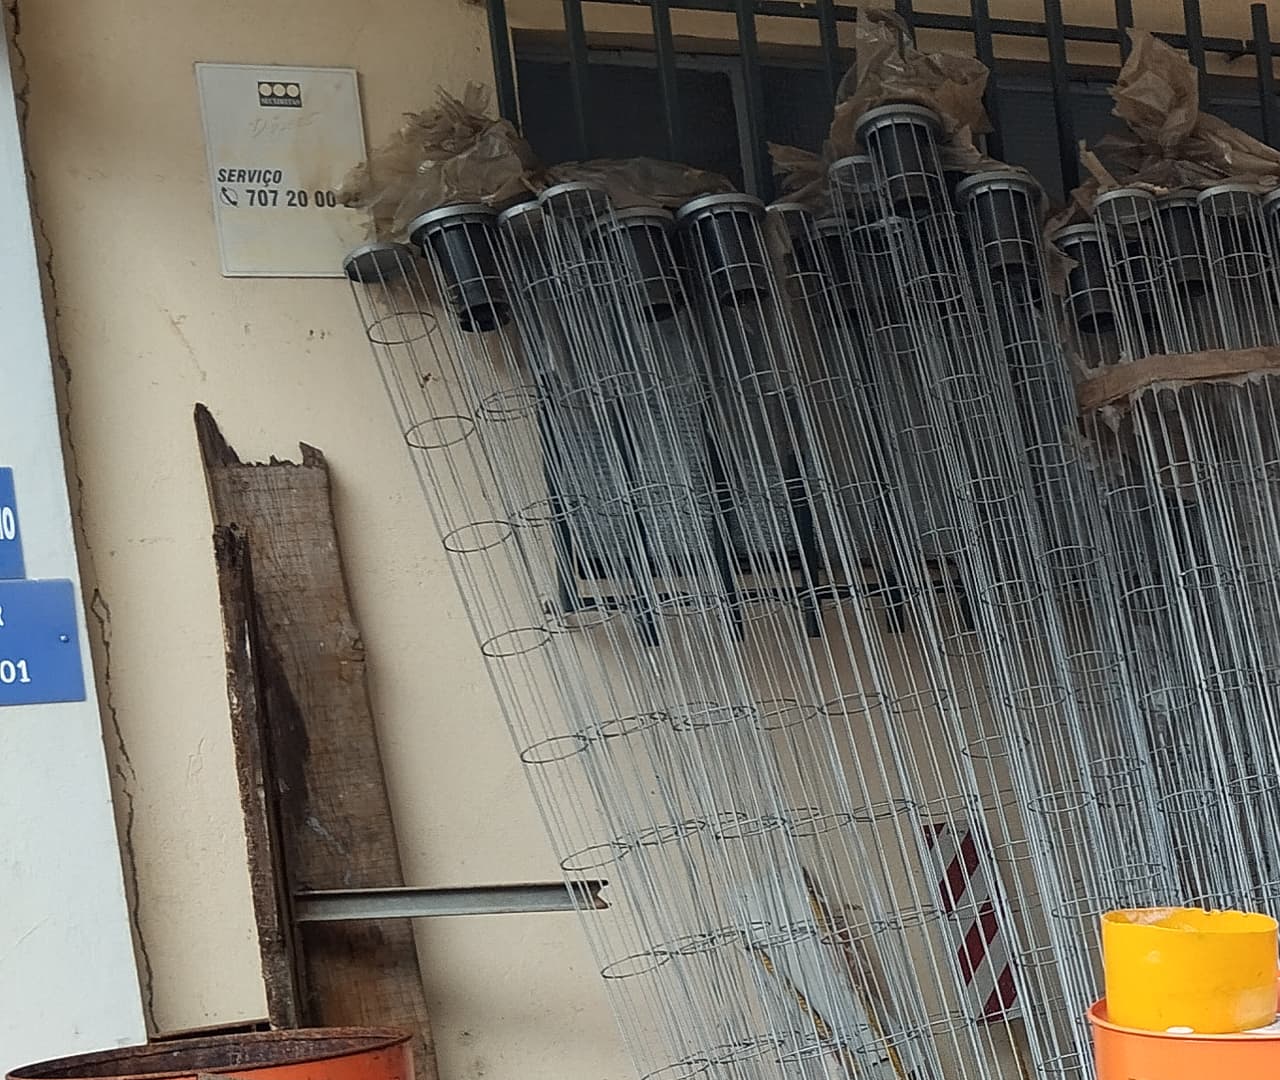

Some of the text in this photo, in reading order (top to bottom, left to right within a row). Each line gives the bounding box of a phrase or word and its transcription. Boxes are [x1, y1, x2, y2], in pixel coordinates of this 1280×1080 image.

[217, 168, 283, 186] SERVIÇO
[246, 189, 279, 206] 707
[286, 190, 308, 207] 20
[314, 190, 337, 208] 00
